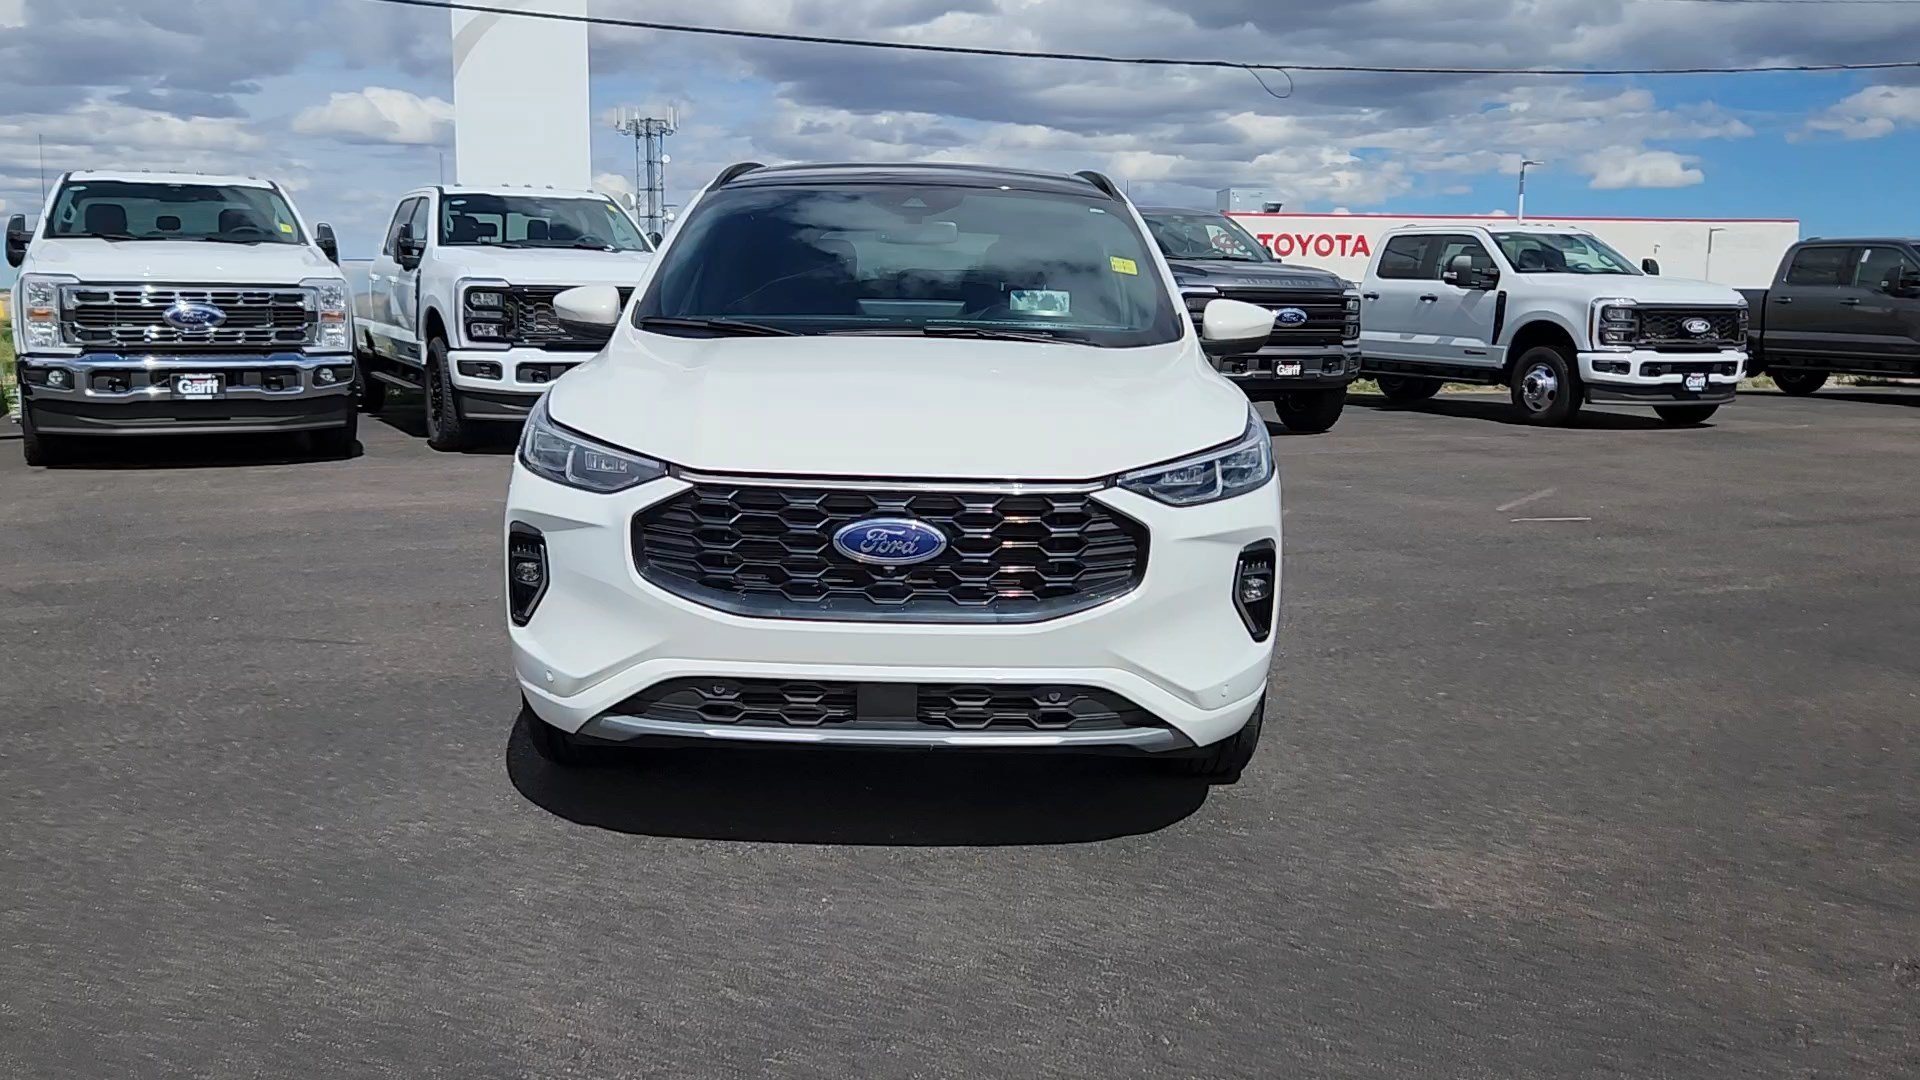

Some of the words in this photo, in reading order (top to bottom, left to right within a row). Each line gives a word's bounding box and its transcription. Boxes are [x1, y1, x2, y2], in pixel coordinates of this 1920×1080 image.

[1257, 233, 1370, 257] TOYOTA
[178, 379, 218, 394] Garff
[860, 528, 920, 554] Ford
